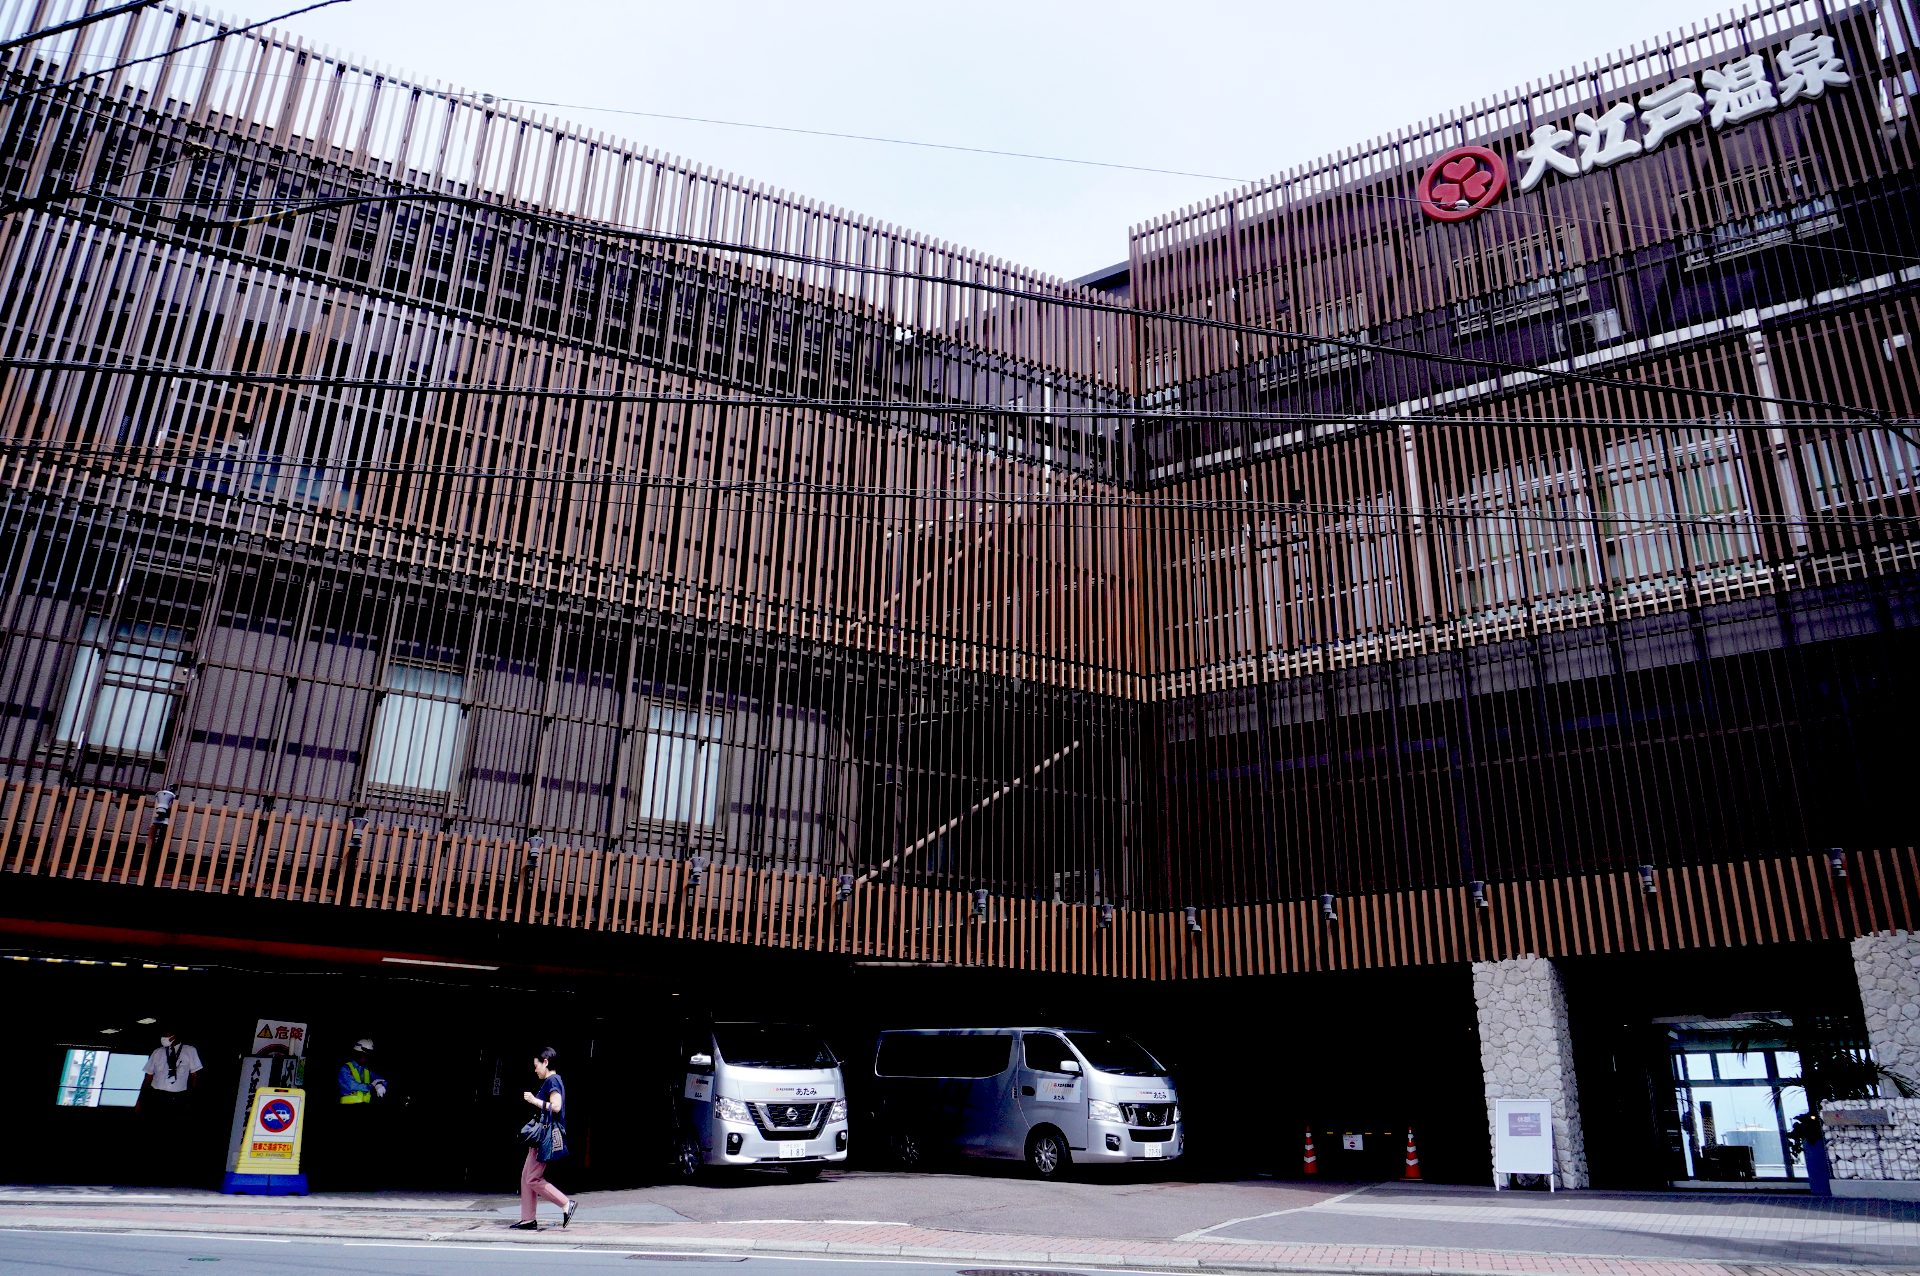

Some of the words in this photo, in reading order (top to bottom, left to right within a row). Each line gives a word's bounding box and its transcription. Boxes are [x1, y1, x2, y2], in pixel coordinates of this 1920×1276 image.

[1515, 32, 1851, 194] 大江戸温泉
[274, 1025, 304, 1041] 危険
[795, 1087, 817, 1096] あたみ
